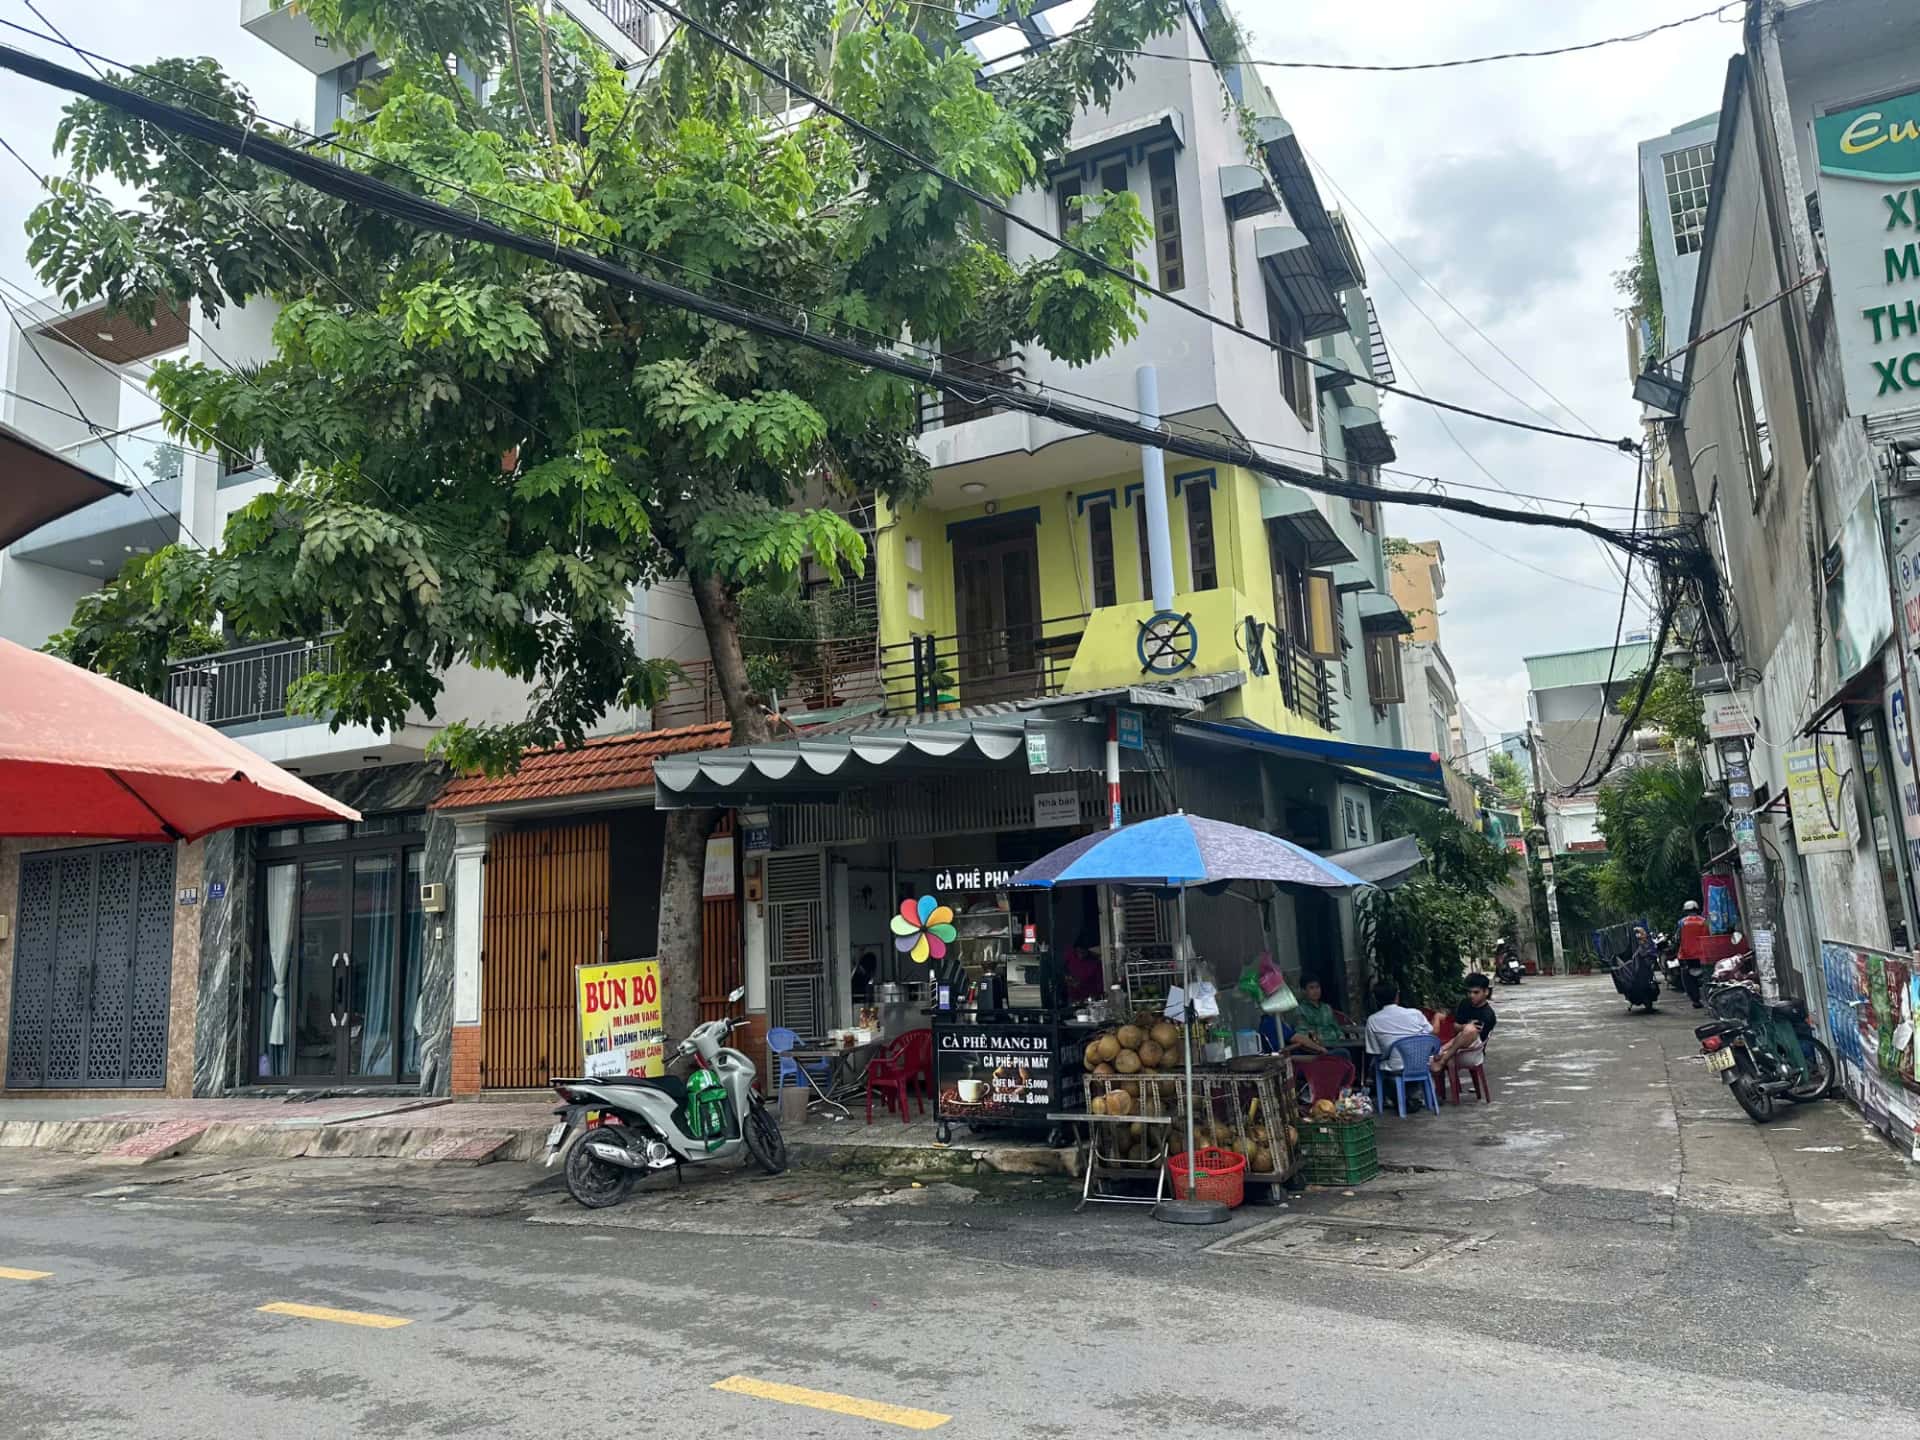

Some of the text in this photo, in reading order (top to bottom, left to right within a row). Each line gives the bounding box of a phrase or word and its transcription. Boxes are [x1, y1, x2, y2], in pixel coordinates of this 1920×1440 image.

[1885, 242, 1920, 284] M
[1863, 299, 1920, 343] TH
[935, 868, 953, 890] CÀ
[956, 867, 981, 889] PHÊ
[585, 965, 657, 1013] BÚN BÒ
[624, 1011, 641, 1025] NAM
[642, 1009, 660, 1022] VANG
[942, 1033, 960, 1049] CÀ
[963, 1033, 988, 1049] PHÊ
[991, 1037, 1030, 1049] MANG
[983, 1053, 994, 1067] CÀ
[996, 1053, 1012, 1068] PHÊ
[1014, 1057, 1029, 1068] PHA
[1031, 1054, 1049, 1068] MÁY
